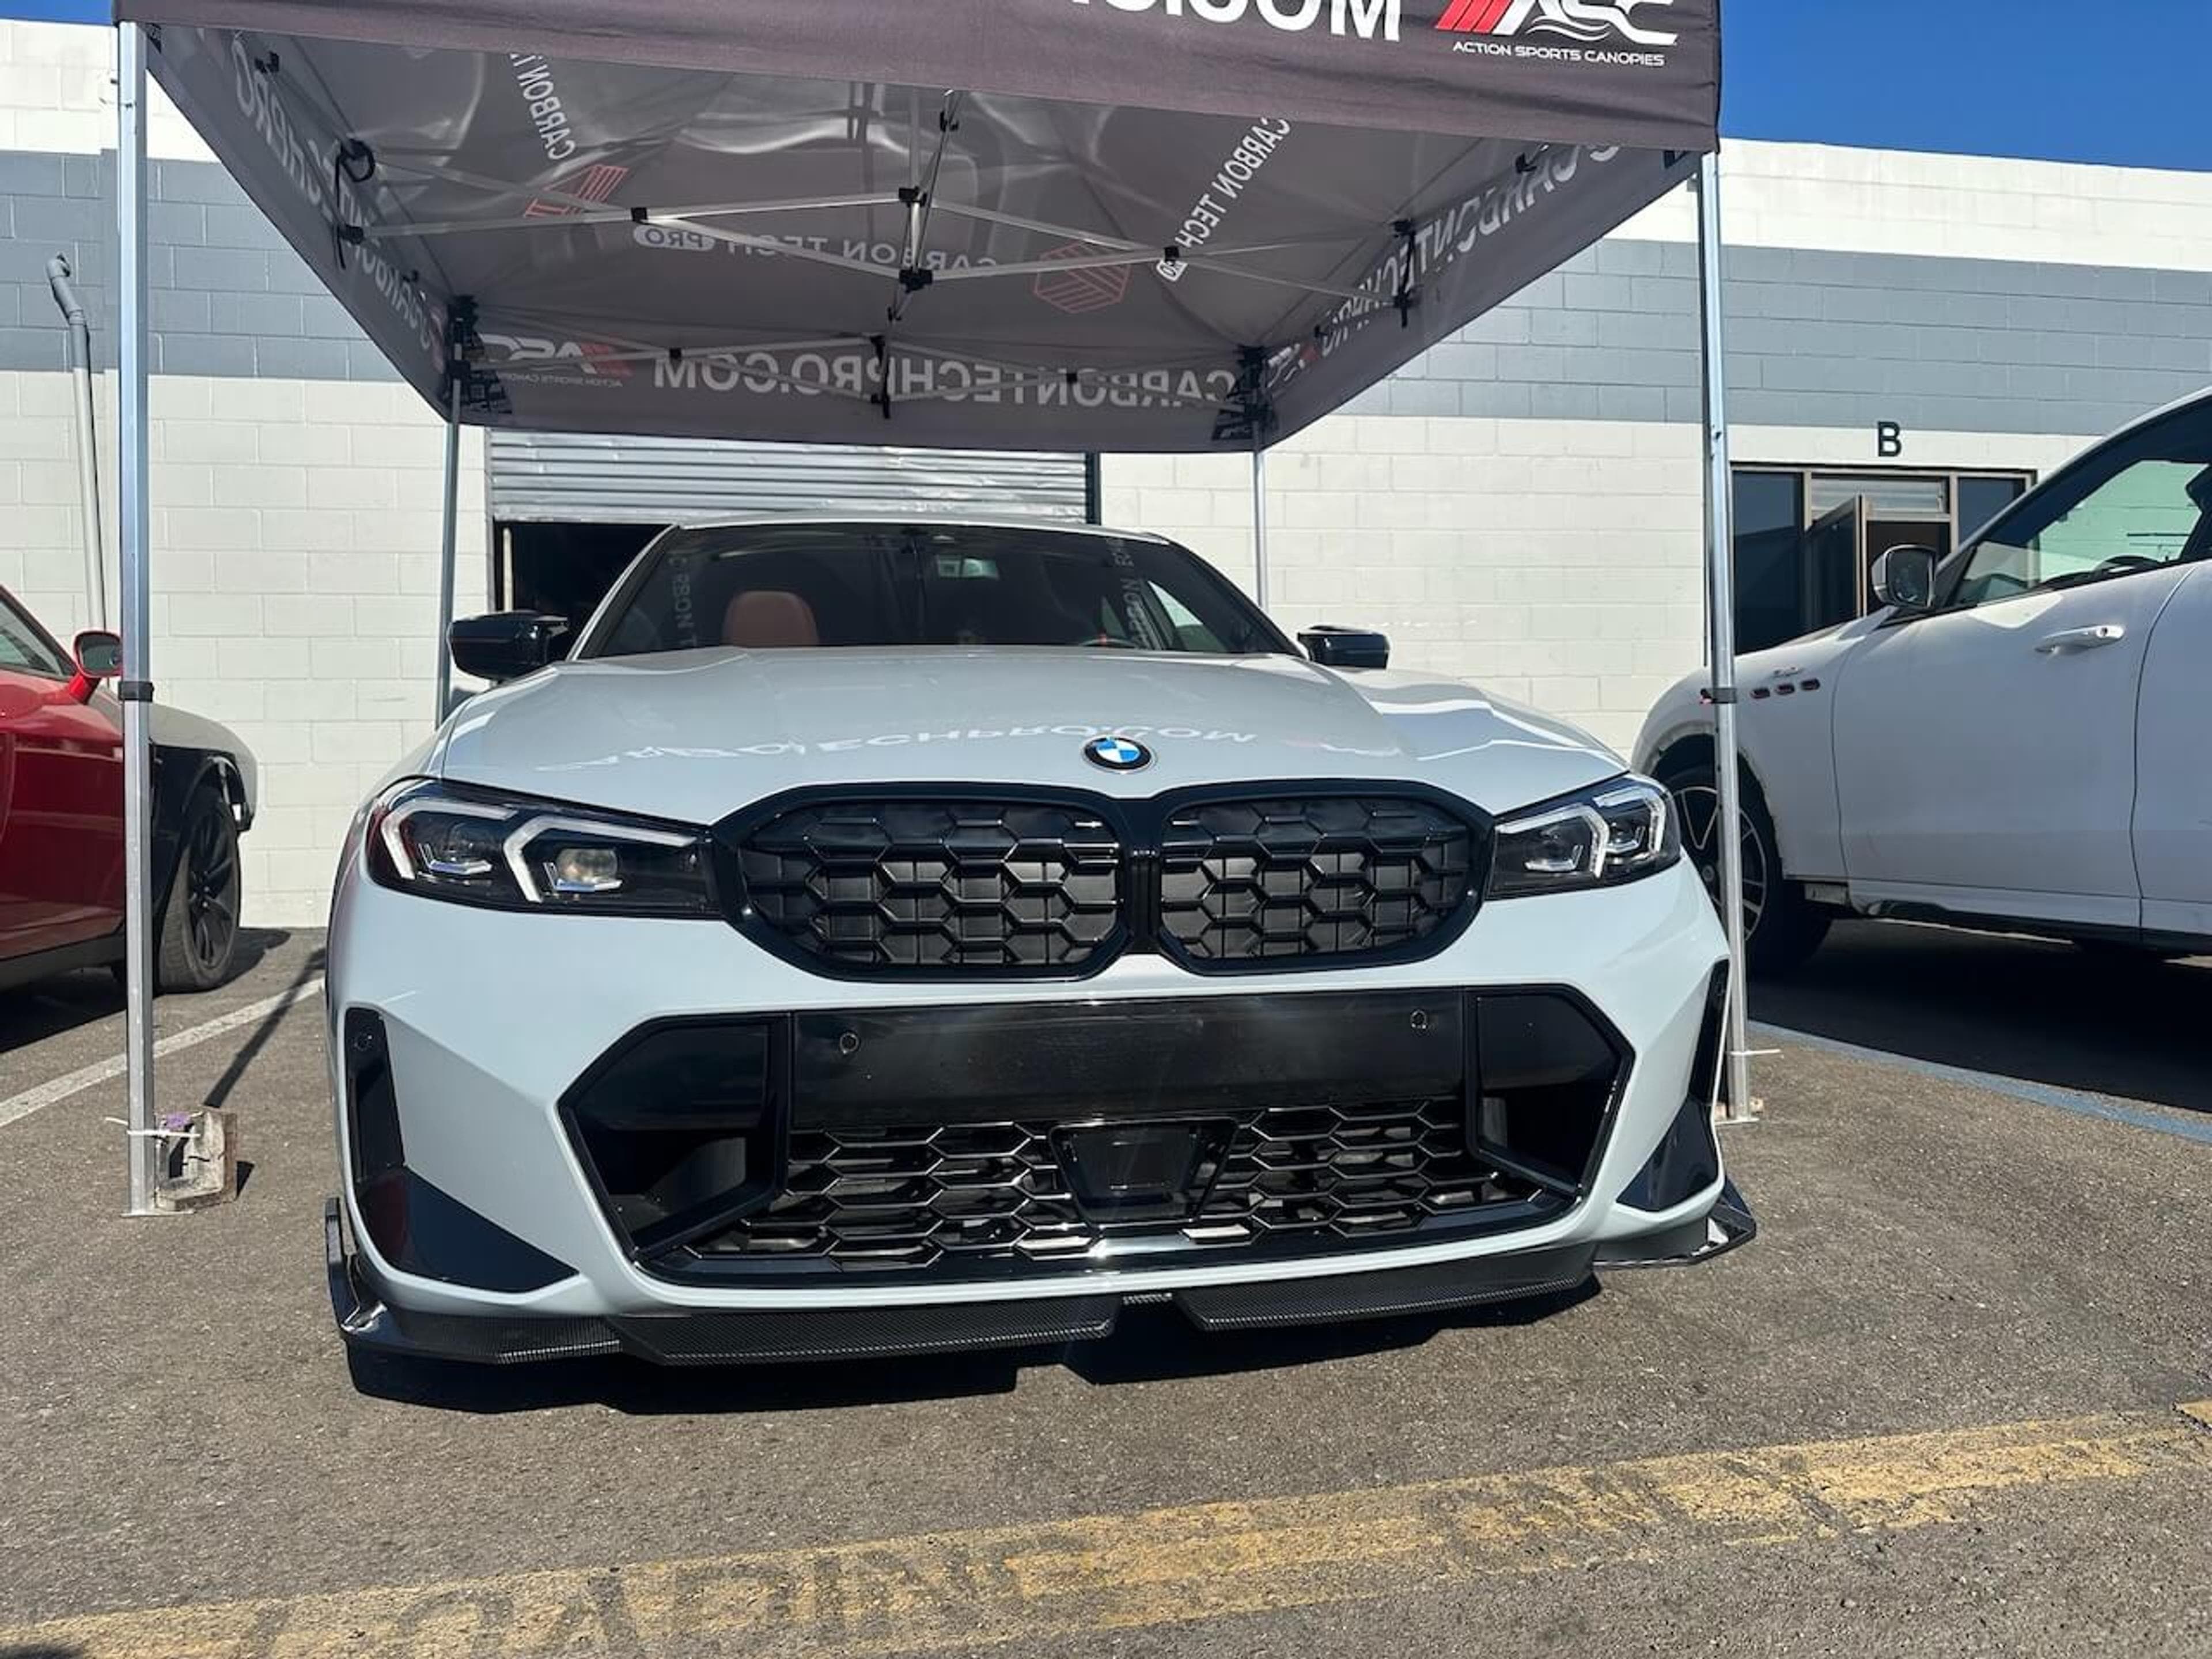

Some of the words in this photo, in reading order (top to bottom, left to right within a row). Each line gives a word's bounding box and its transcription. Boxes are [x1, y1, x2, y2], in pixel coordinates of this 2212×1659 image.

[1453, 41, 1512, 56] ACTION
[1514, 46, 1582, 62] SPORTS
[1584, 50, 1665, 67] CANOPIES
[1878, 421, 1902, 457] B
